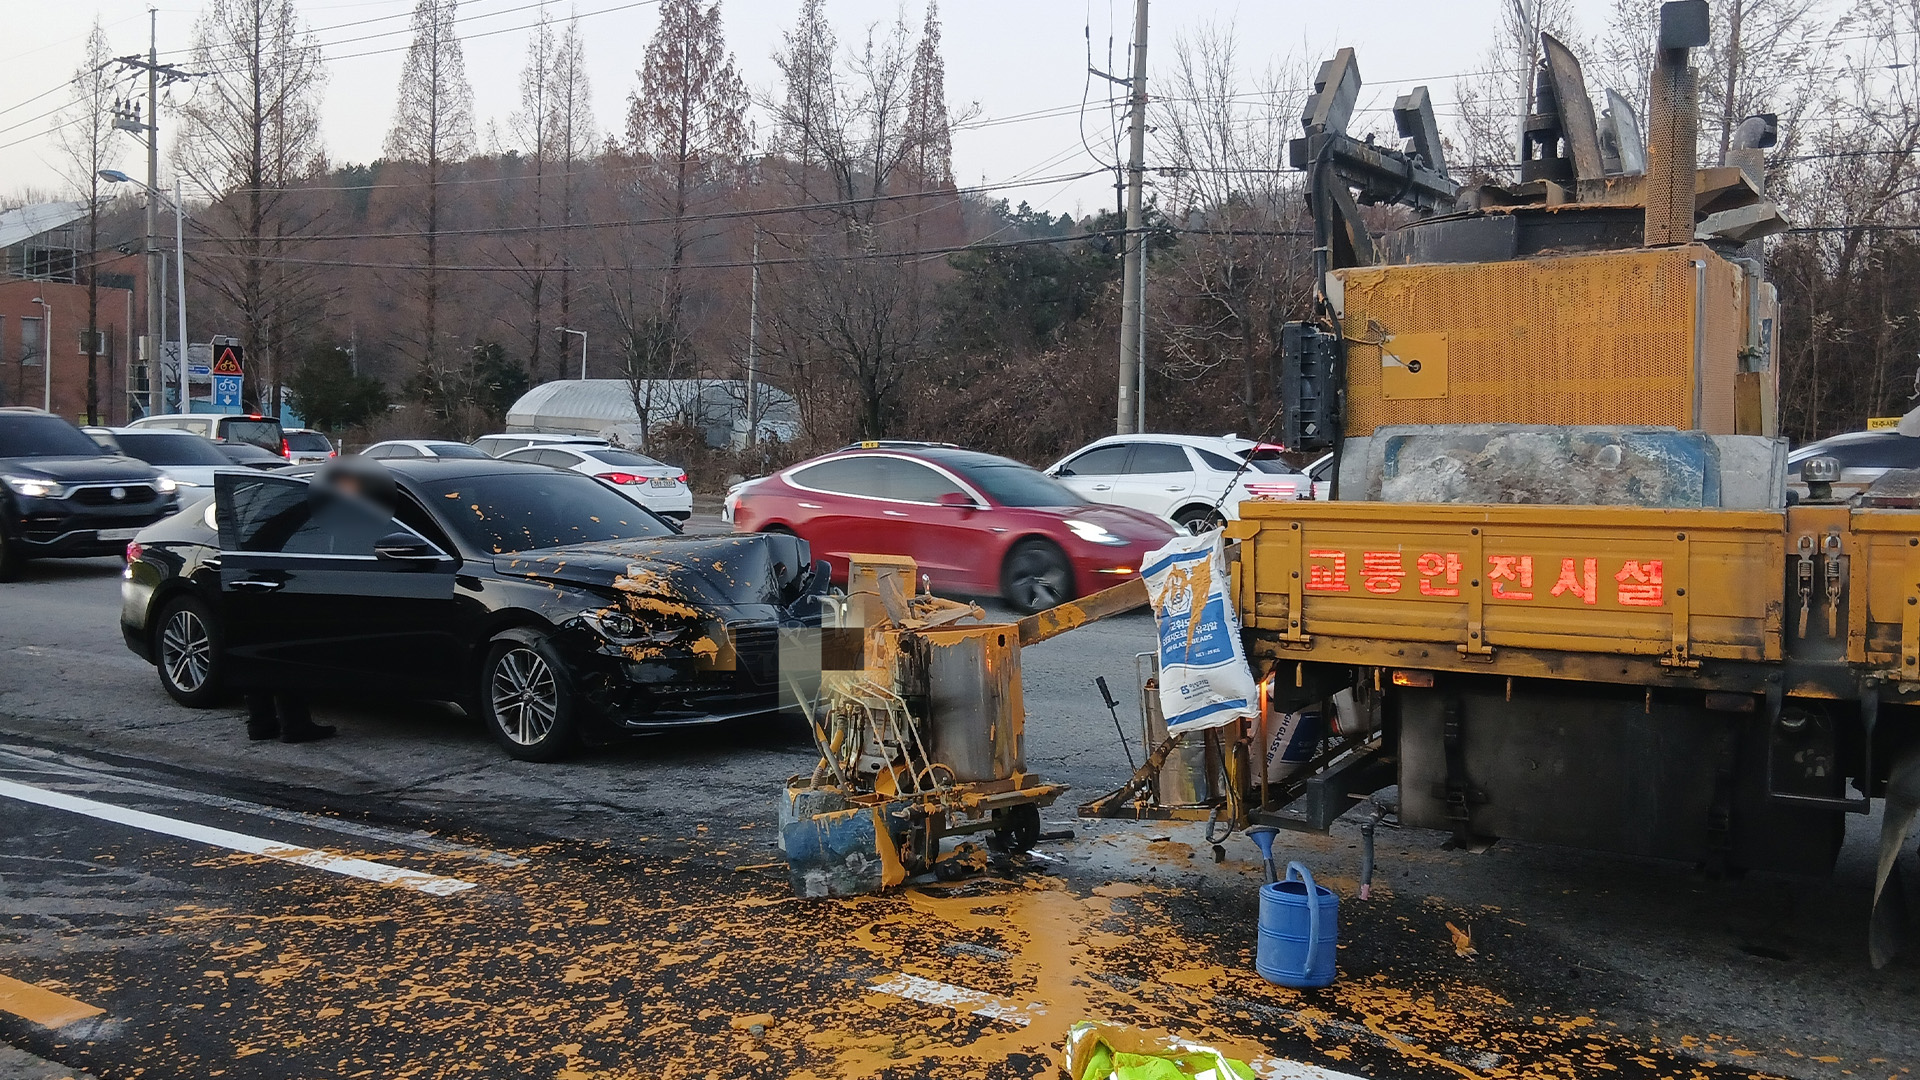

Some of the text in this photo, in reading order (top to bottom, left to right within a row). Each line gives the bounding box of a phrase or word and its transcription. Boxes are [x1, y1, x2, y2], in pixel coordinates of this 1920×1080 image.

[1305, 549, 1664, 607] 교통안전시설
[1281, 712, 1293, 728] GH
[1270, 727, 1286, 752] GLASS
